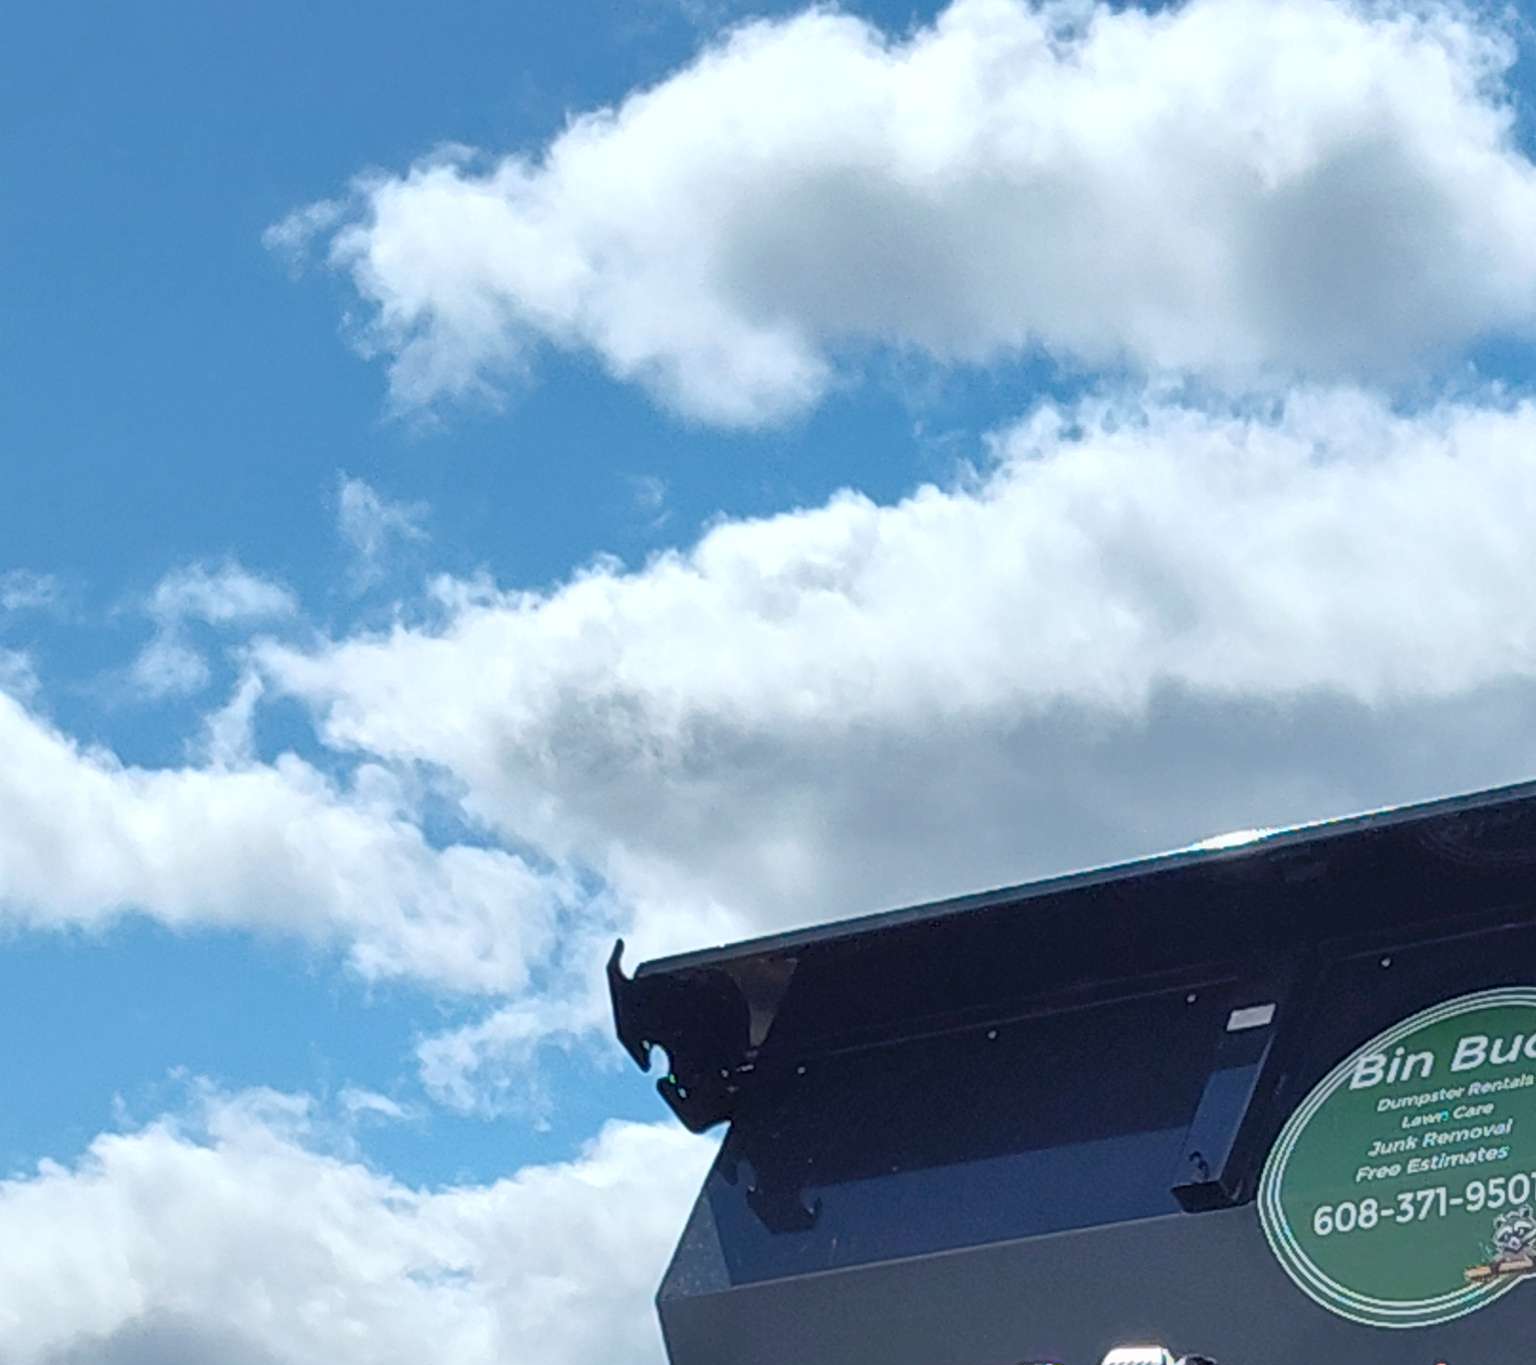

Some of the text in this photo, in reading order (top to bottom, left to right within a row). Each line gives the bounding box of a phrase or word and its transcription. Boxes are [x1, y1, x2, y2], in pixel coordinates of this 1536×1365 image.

[1348, 1046, 1435, 1091] Bin
[1376, 1072, 1535, 1112] Dumpster Rentals
[1401, 1101, 1495, 1129] Lawn Care
[1367, 1118, 1514, 1158] Junk Removal
[1355, 1144, 1510, 1183] Free Estimates
